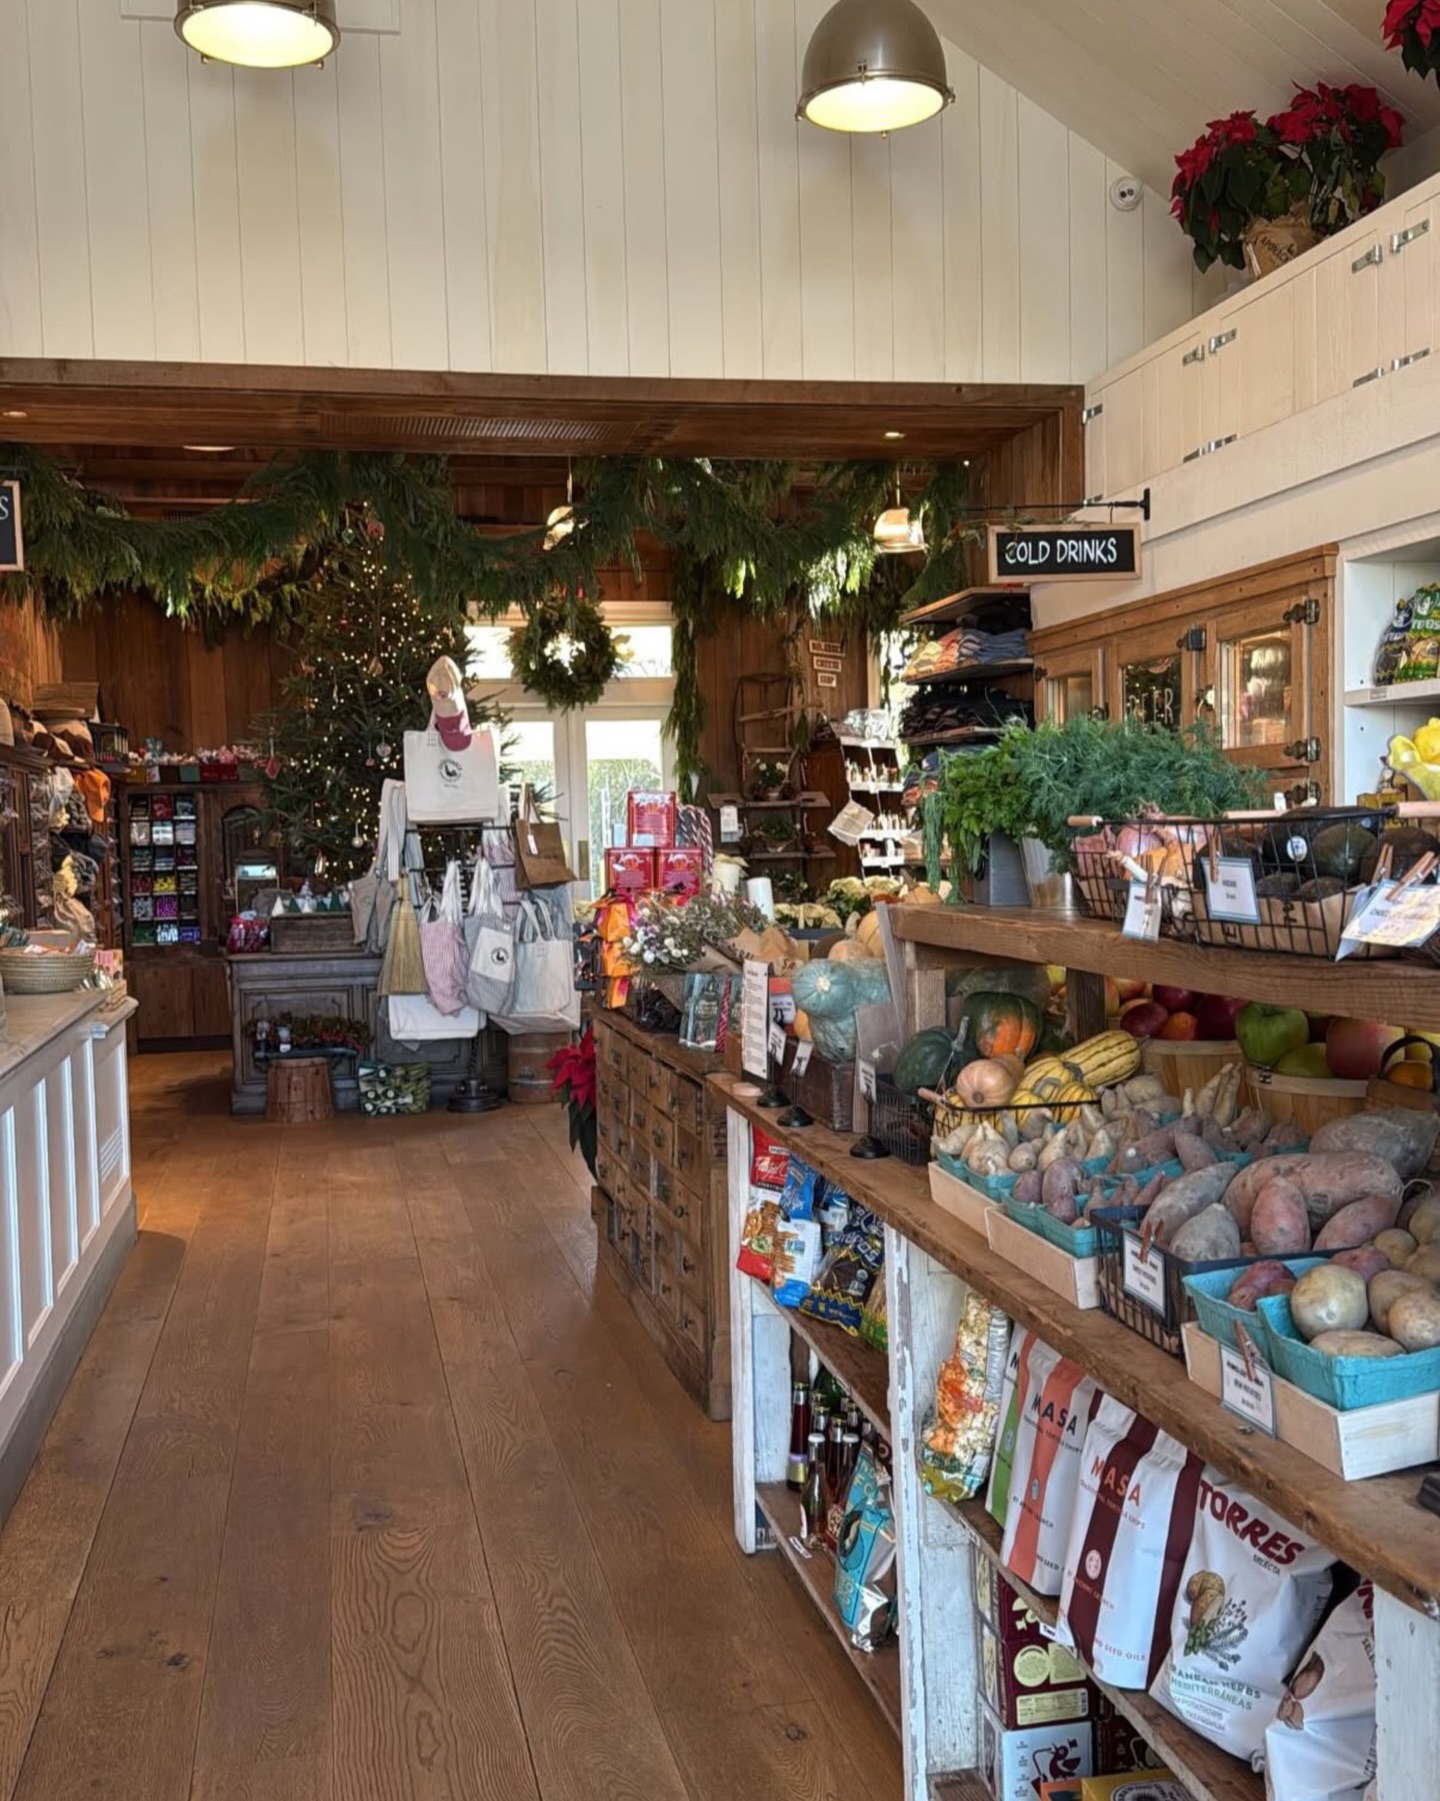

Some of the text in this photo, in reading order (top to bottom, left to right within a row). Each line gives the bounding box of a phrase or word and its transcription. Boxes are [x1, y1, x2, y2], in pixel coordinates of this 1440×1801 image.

[1005, 537, 1118, 565] COLD DRINKS
[1031, 1392, 1078, 1436] MASA
[1090, 1455, 1142, 1508] MASA
[1199, 1477, 1306, 1566] TORRES
[1252, 1553, 1282, 1577] SELECTA
[1104, 1640, 1124, 1657] SEED
[1125, 1651, 1146, 1662] OILS
